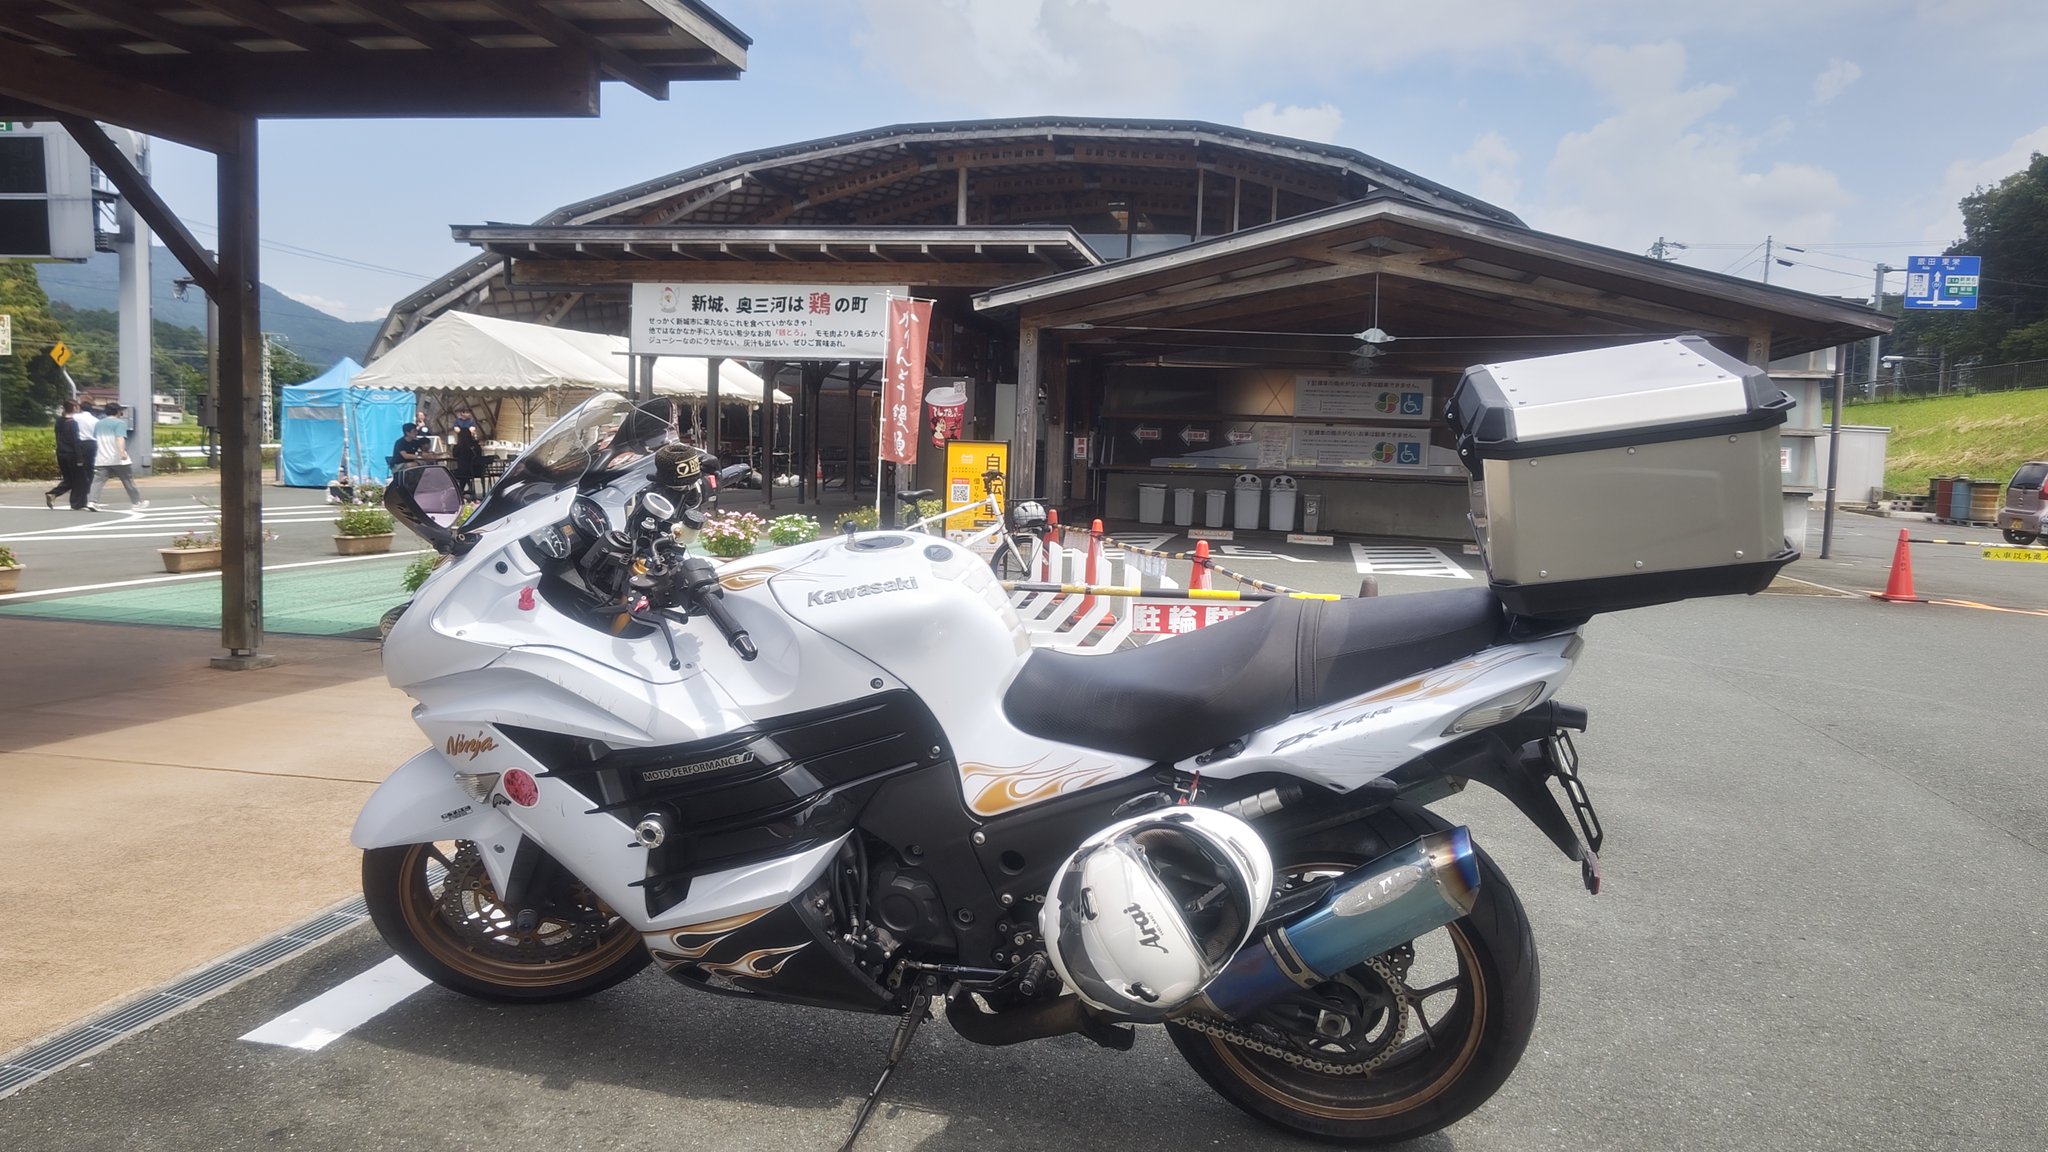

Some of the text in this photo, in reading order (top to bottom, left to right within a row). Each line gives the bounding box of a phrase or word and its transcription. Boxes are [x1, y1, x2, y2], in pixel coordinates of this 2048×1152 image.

[692, 292, 868, 316] 新城、奥三河は鶏の町
[807, 576, 919, 608] Kawasaki
[1271, 705, 1394, 754] ZX-14R
[446, 730, 499, 761] Ninja
[642, 755, 740, 781] MOTO PERFORMANCE
[1123, 902, 1169, 954] Arai
